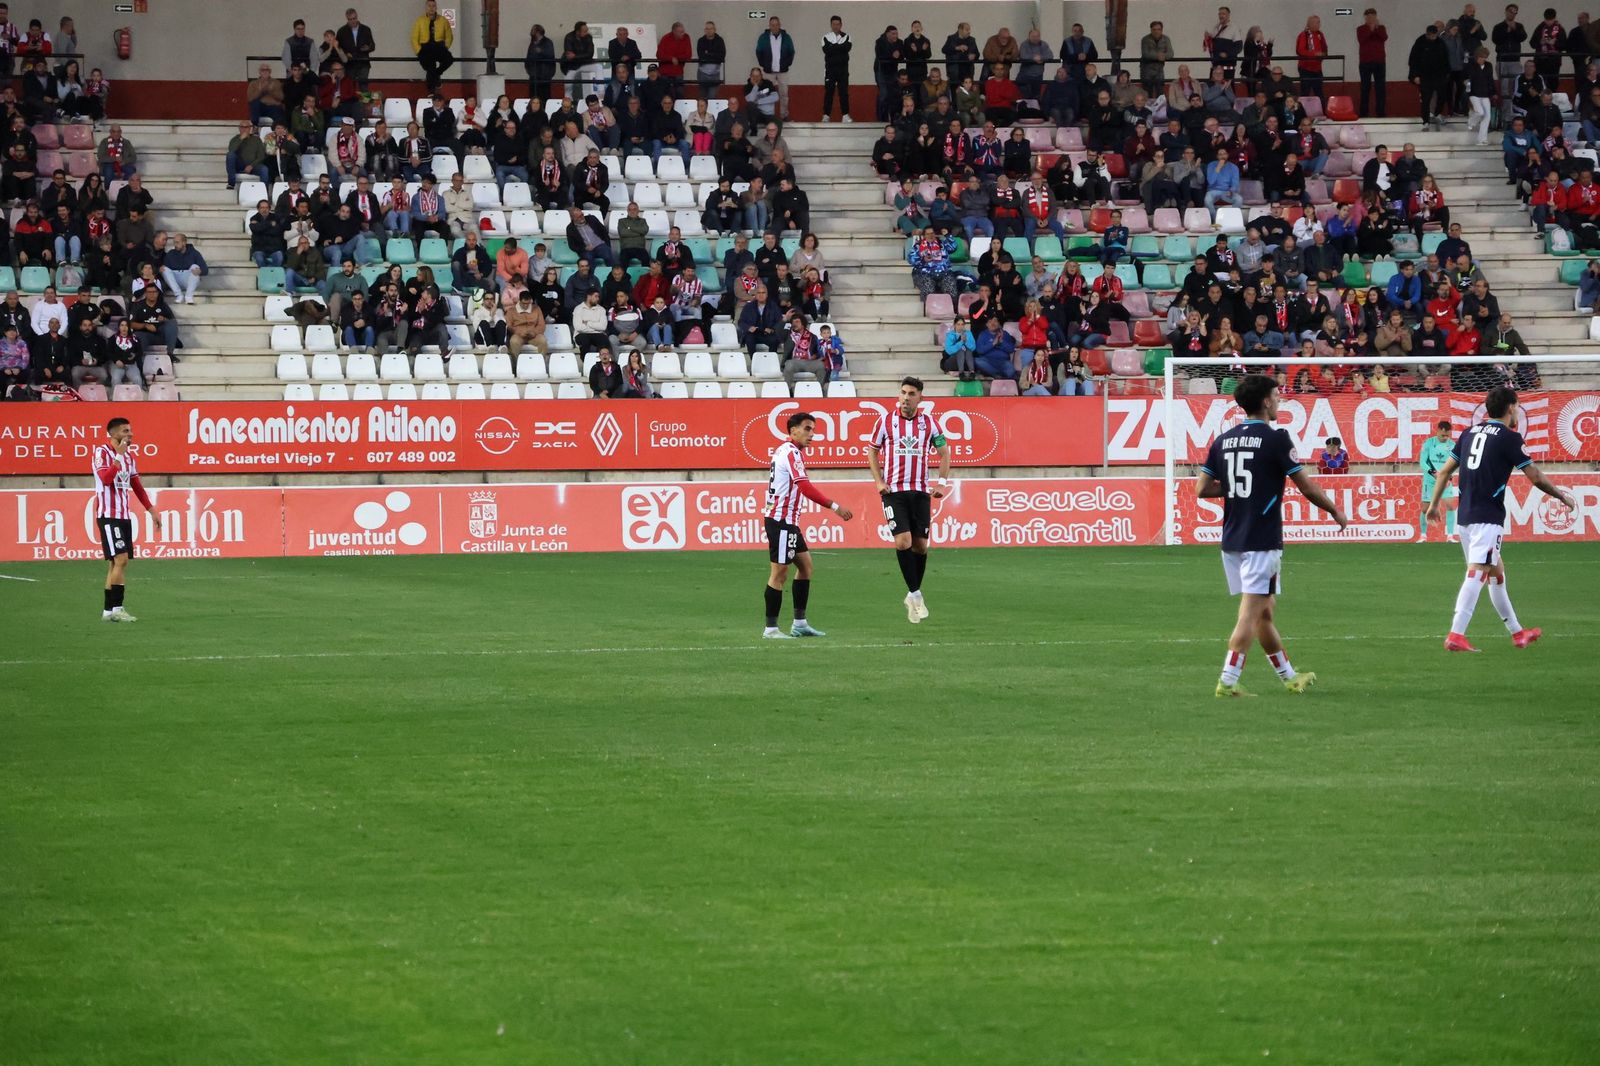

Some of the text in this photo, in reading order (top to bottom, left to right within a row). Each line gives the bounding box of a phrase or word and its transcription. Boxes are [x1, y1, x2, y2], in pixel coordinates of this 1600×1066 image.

[188, 404, 456, 444] Saneamientos Atilano
[649, 420, 687, 433] Grupo
[1354, 397, 1439, 460] CF
[1, 425, 112, 439] AURANT
[650, 434, 727, 448] Leomotor
[1222, 436, 1262, 450] IKER ALDAI
[16, 443, 158, 458] DEL DRO
[767, 445, 868, 457] EUTIDOS
[1467, 432, 1488, 470] 9
[189, 453, 220, 465] Pza.
[225, 453, 279, 464] Cuartel
[284, 452, 322, 466] Viejo
[326, 452, 335, 463] 7
[366, 452, 393, 462] 607
[398, 452, 425, 462] 489
[429, 451, 456, 462] 002
[1224, 451, 1254, 498] 15
[1358, 482, 1386, 495] del
[696, 489, 756, 514] Carné
[986, 486, 1135, 512] Escuela
[1197, 489, 1406, 523] Siller
[16, 494, 245, 545] La inión
[114, 526, 121, 538] 8
[501, 524, 567, 537] Junta de
[697, 519, 845, 544] Castilla eón
[990, 517, 1136, 544] infantil
[308, 529, 396, 550] juventud
[460, 539, 568, 552] Castilla y León
[788, 533, 798, 548] 22
[33, 547, 49, 559] El
[54, 546, 104, 559] Corre
[154, 545, 220, 558] Zamora
[323, 548, 360, 556] castilla
